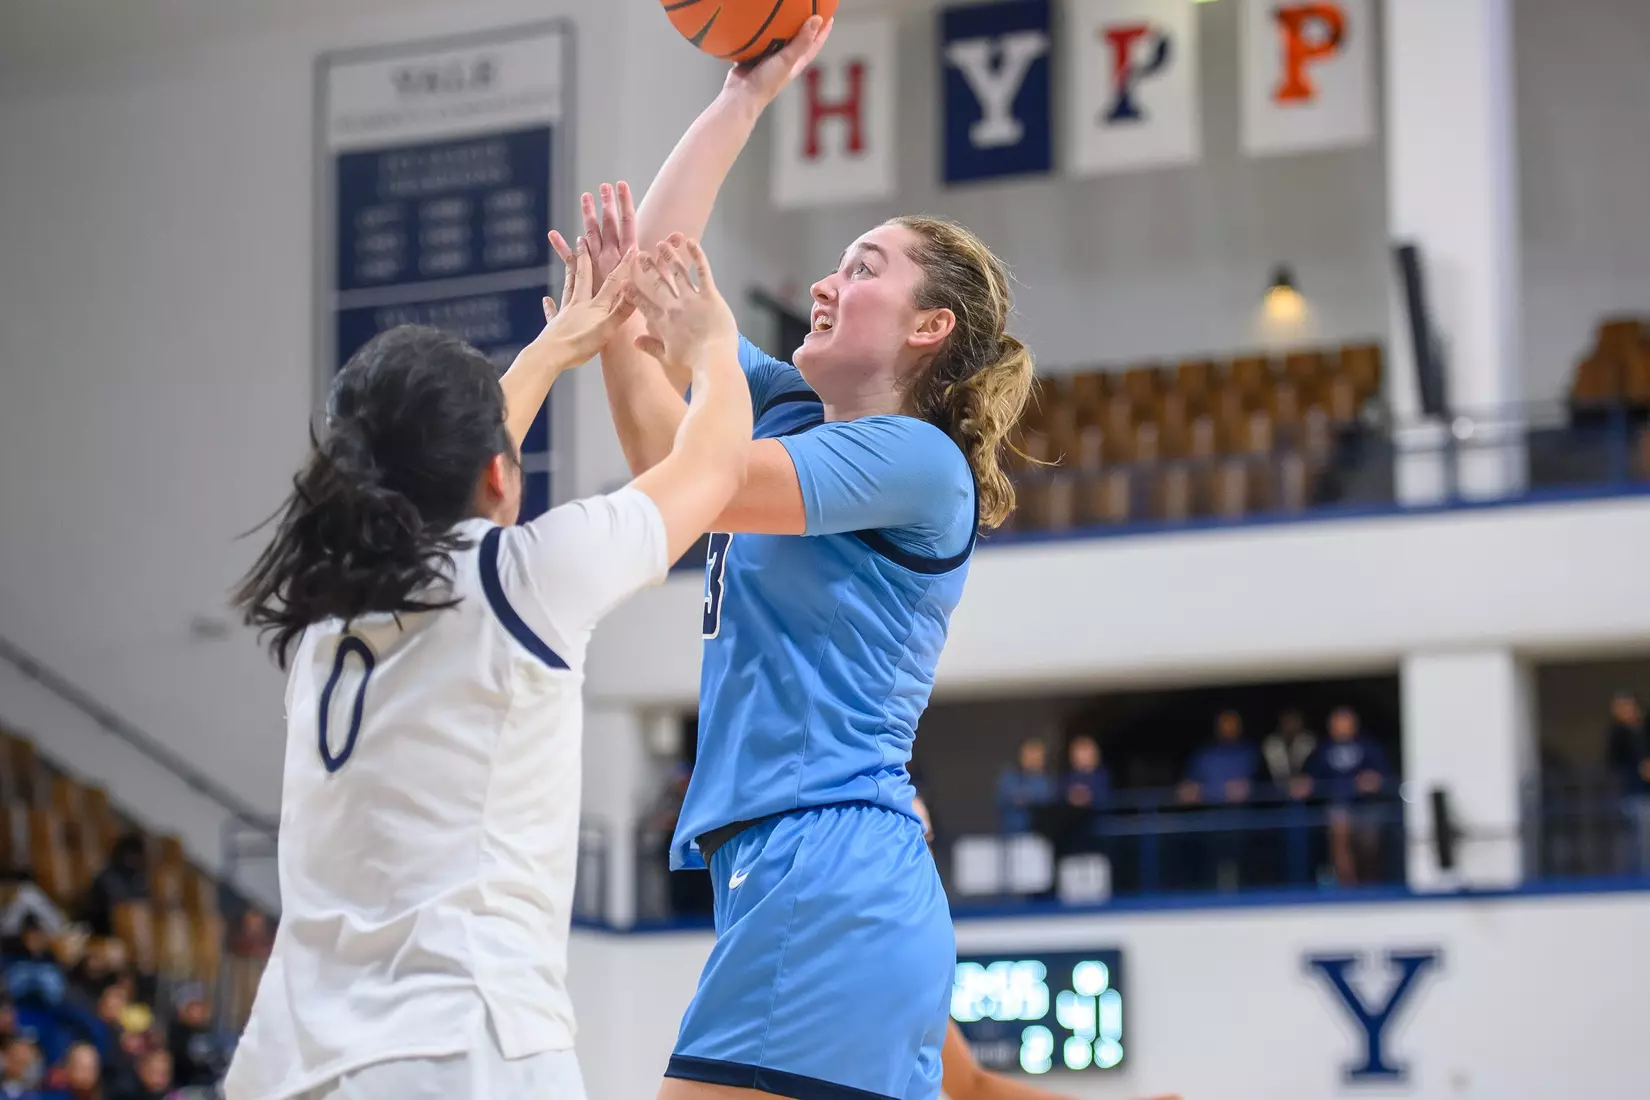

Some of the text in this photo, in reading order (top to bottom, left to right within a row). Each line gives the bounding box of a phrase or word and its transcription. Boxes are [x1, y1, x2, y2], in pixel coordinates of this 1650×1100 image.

[943, 31, 1049, 149] Y
[1102, 22, 1172, 124] P
[1273, 3, 1347, 106] P
[801, 60, 866, 160] H
[318, 635, 375, 774] 0
[1303, 949, 1441, 1082] Y
